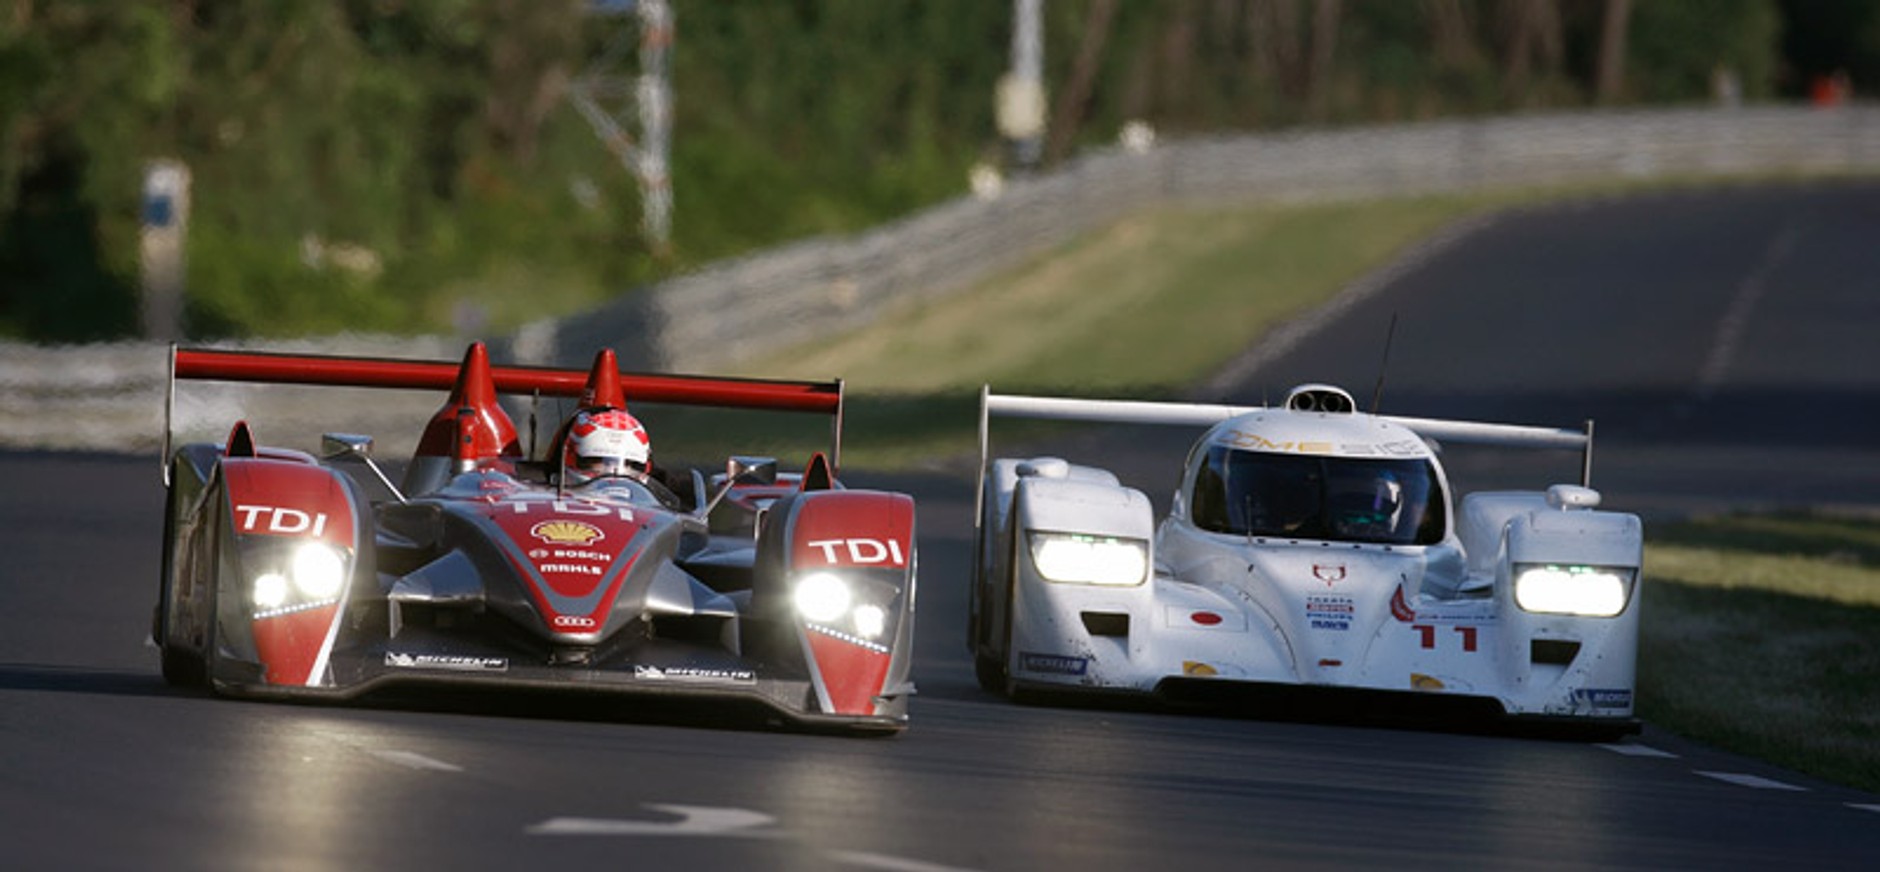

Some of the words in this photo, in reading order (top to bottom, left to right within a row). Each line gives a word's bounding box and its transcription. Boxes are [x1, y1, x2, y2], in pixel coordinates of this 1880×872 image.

[236, 505, 327, 538] TDI
[554, 550, 611, 561] BOSCH
[807, 538, 904, 565] TDI
[540, 564, 602, 575] MAHLE
[1411, 624, 1477, 652] 11
[416, 655, 503, 665] MICHELIN
[665, 667, 752, 678] MICHELIN
